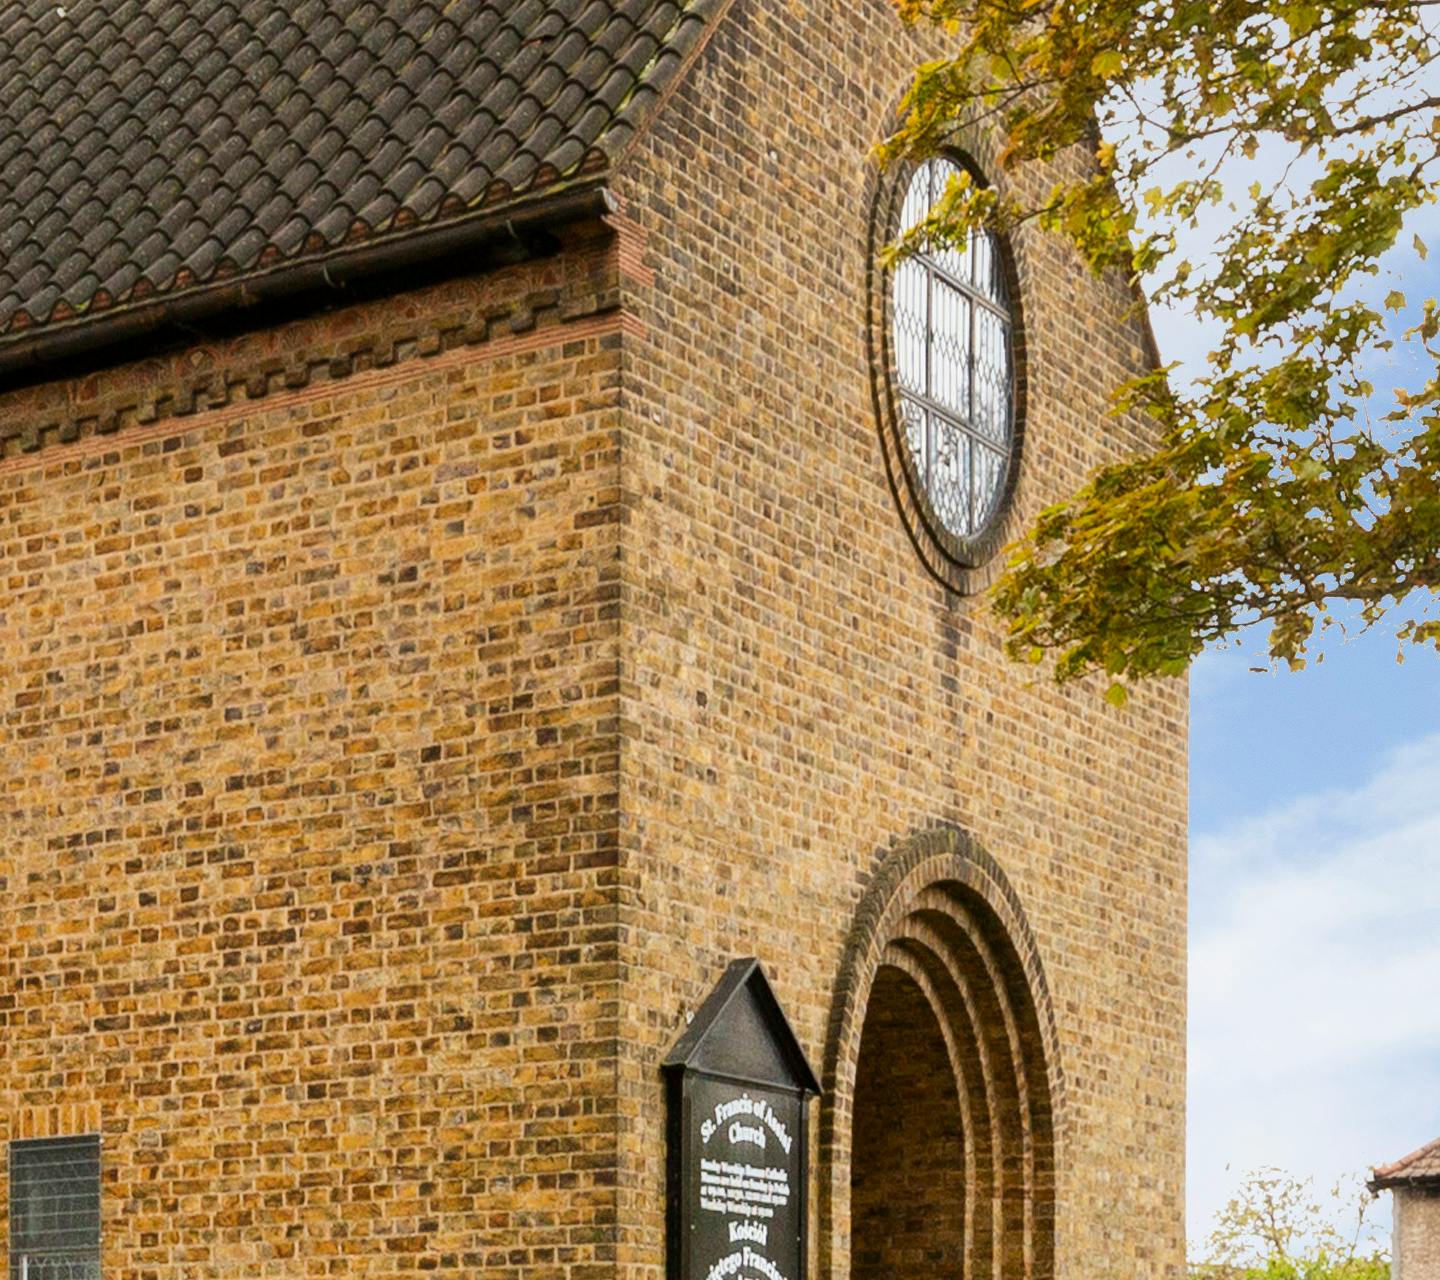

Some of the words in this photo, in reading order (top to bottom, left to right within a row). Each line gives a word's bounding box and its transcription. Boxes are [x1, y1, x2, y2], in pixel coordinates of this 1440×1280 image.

[715, 1093, 753, 1125] Francis
[754, 1100, 767, 1119] of
[729, 1121, 766, 1149] Church
